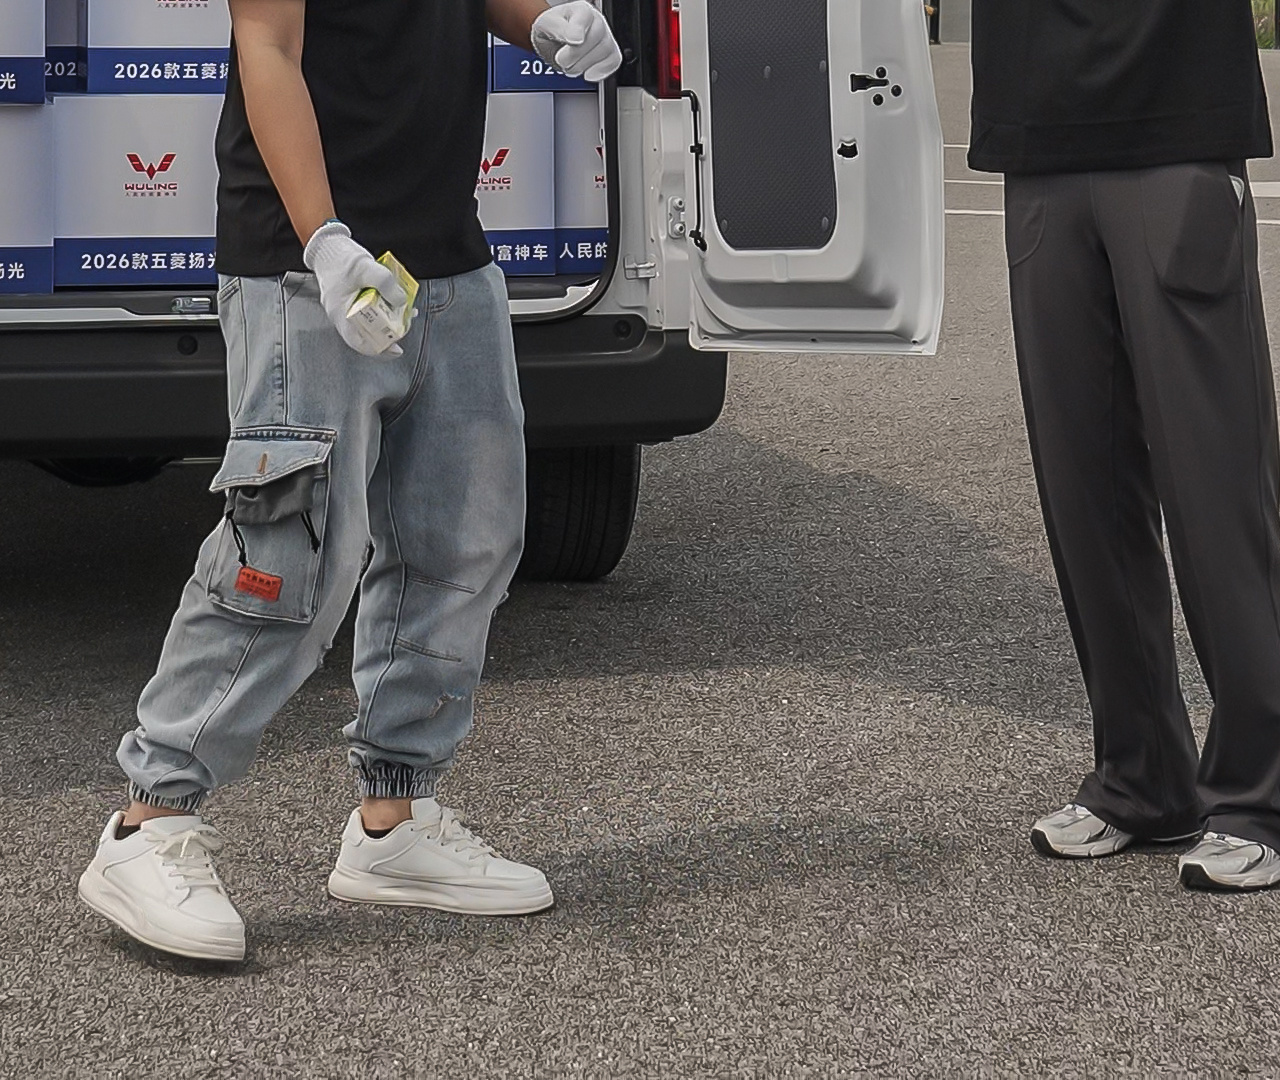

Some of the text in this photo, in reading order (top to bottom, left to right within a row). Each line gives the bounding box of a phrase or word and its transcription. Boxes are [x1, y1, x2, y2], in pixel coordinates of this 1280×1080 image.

[124, 182, 178, 191] WULING
[490, 243, 549, 262] 富神车
